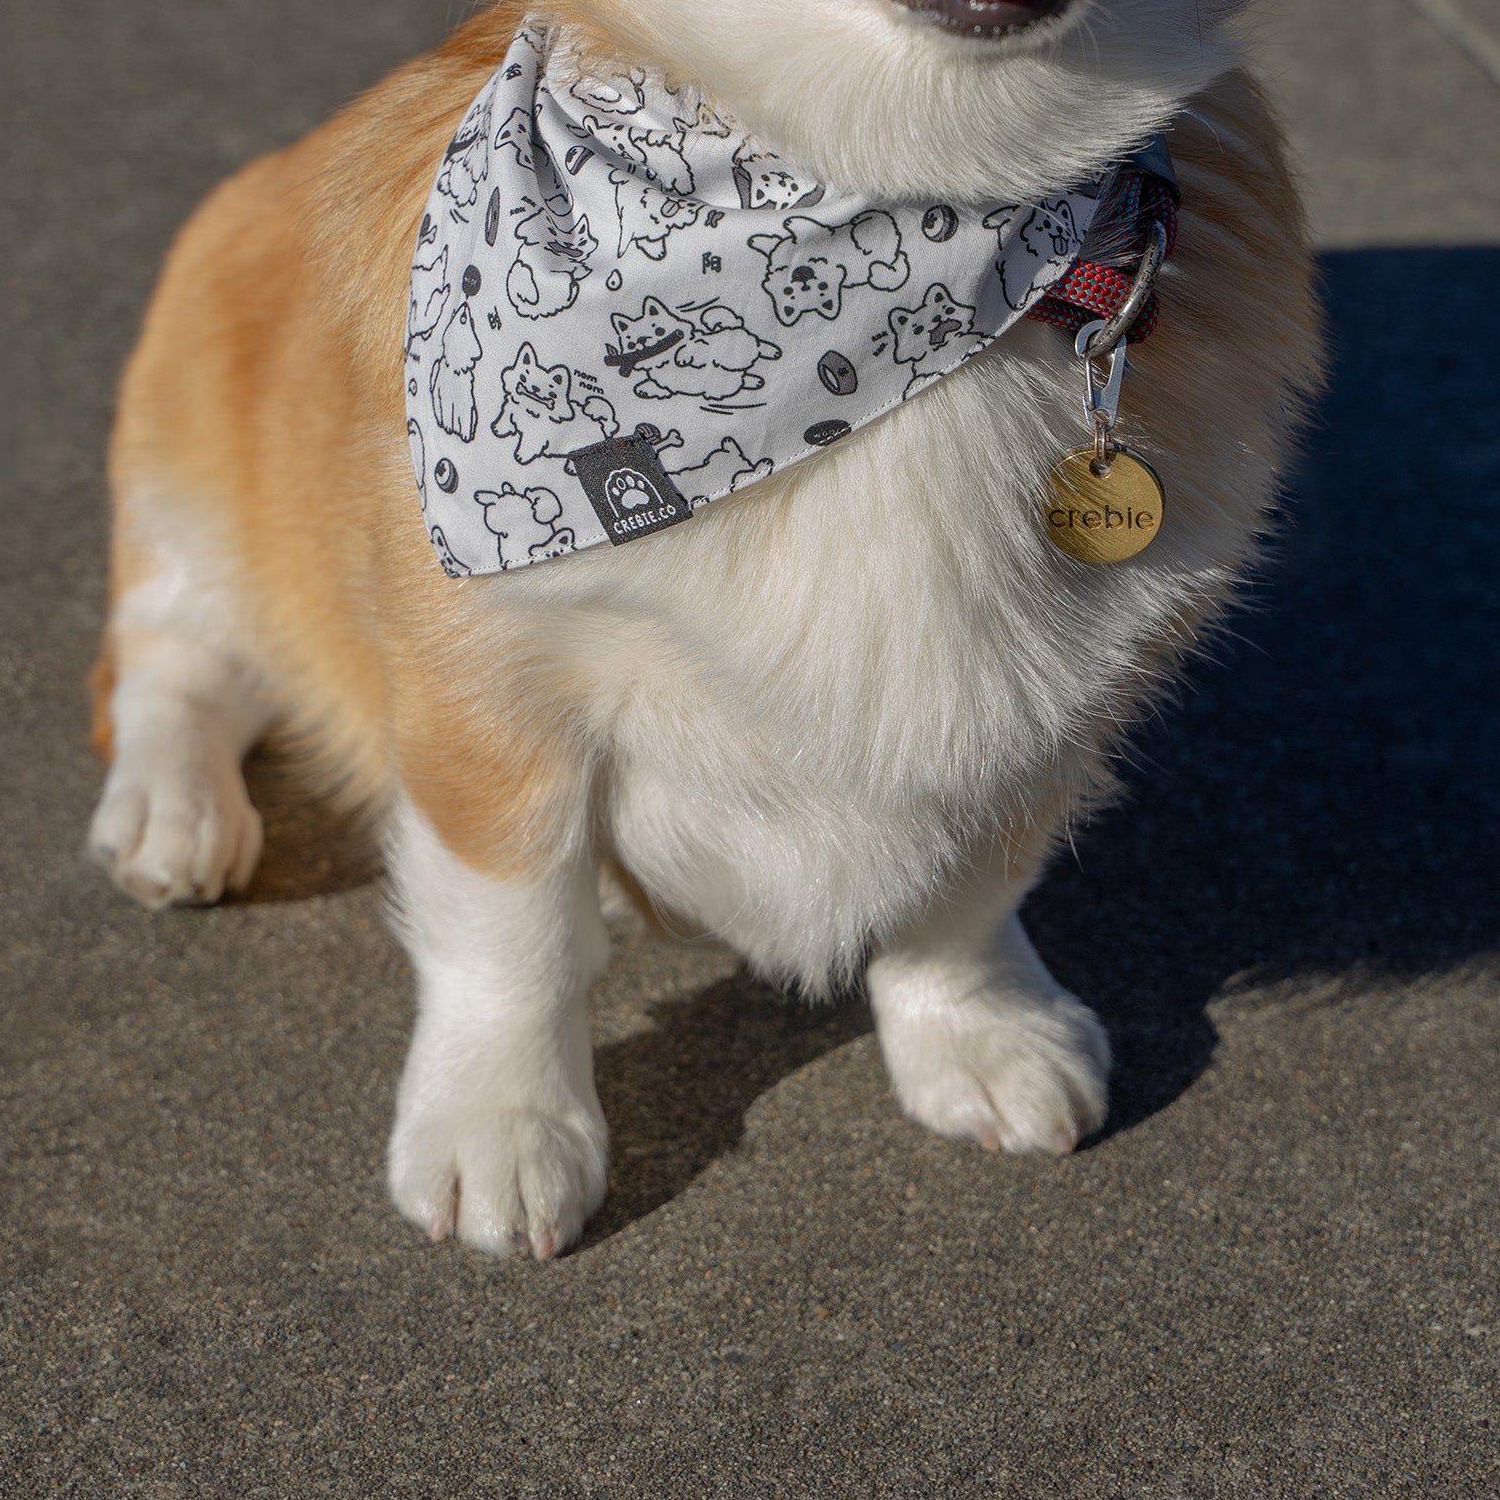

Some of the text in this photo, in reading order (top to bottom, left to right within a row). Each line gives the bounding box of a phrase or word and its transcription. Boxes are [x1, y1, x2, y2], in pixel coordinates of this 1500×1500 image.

[573, 368, 598, 383] nom
[579, 380, 605, 395] nom
[613, 504, 676, 535] CREBIE.CO
[1048, 504, 1155, 530] crebie
